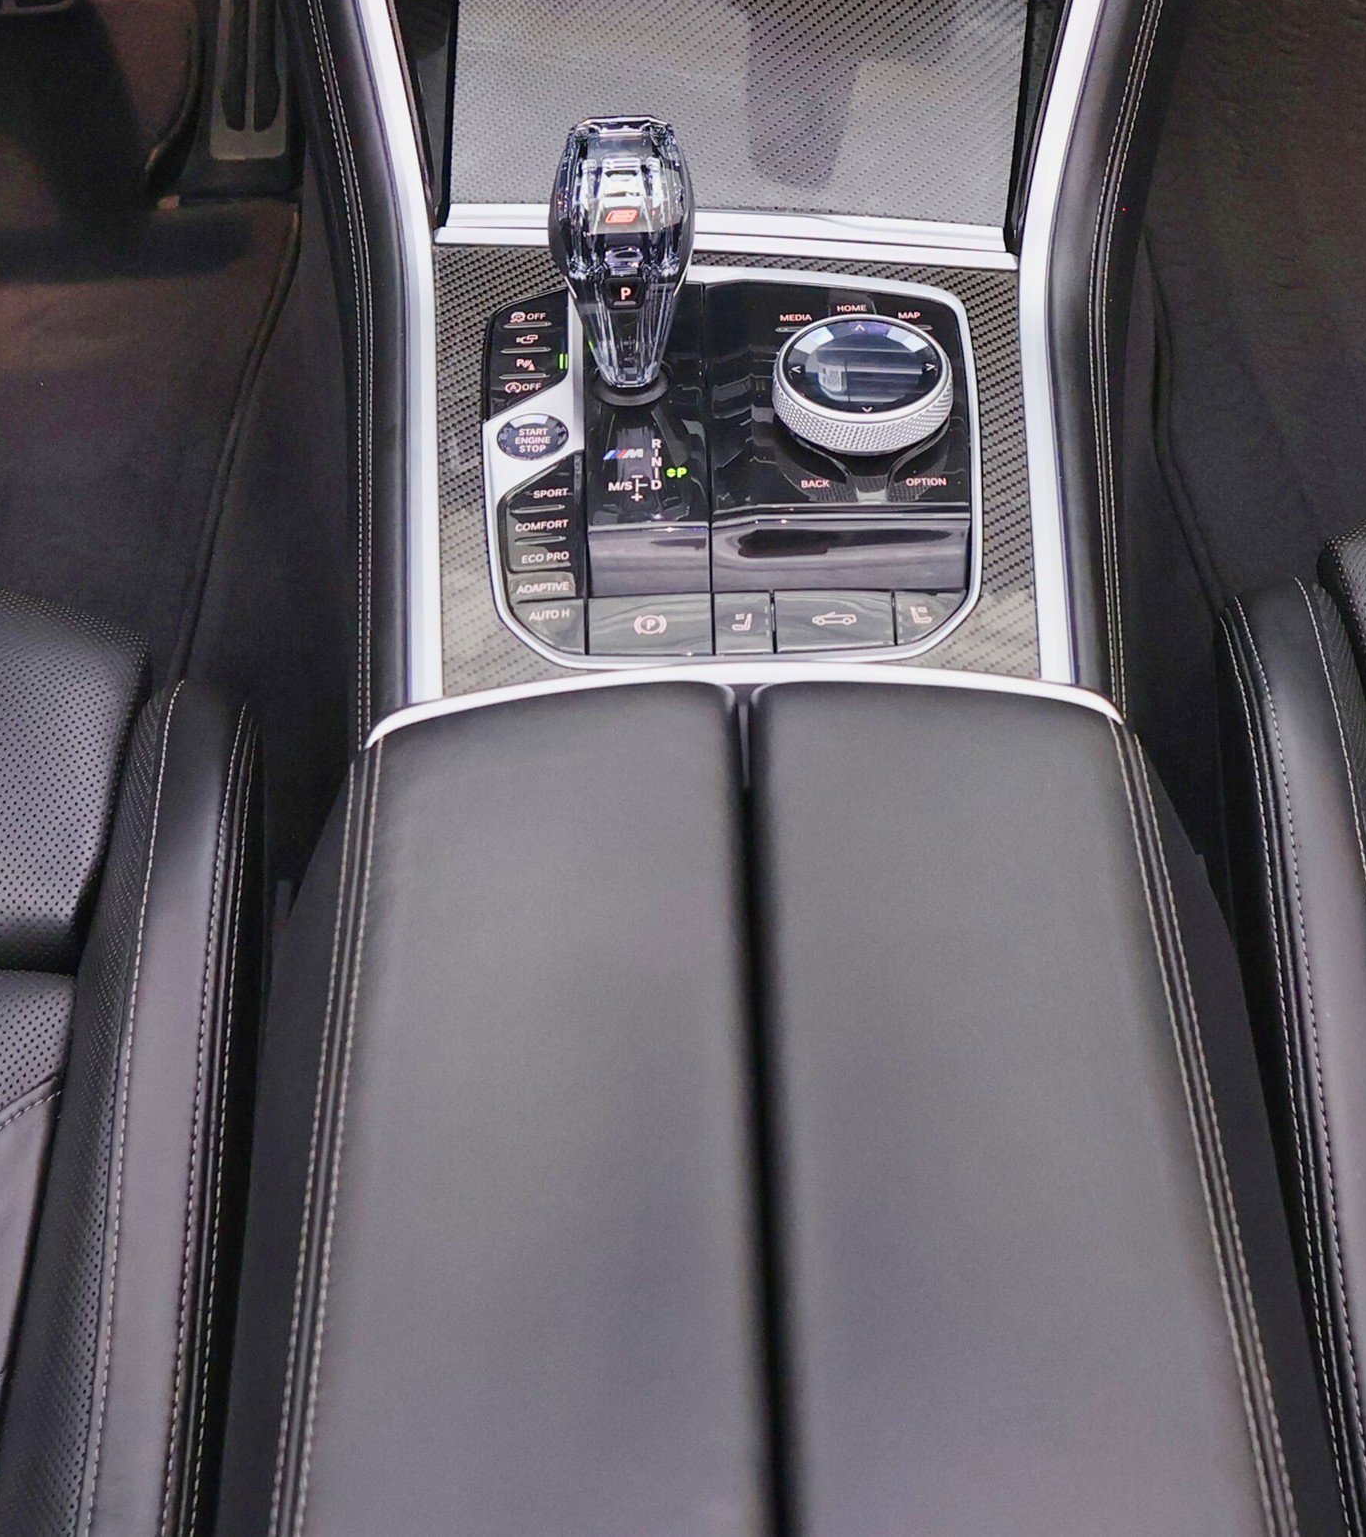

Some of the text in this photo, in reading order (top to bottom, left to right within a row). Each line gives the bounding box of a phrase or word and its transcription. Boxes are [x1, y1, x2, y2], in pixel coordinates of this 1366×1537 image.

[620, 287, 632, 300] P
[837, 305, 867, 313] HOME
[526, 312, 546, 321] OFF
[779, 314, 813, 322] MEDIA
[898, 311, 921, 319] MAP
[521, 383, 542, 391] OFF
[518, 428, 548, 436] START
[514, 436, 551, 444] ENGINE
[519, 445, 547, 453] STOP
[608, 481, 633, 492] M/S
[800, 479, 831, 489] BACK
[905, 477, 947, 487] OPTION
[533, 487, 569, 499] SPORT
[515, 519, 569, 533] COMFORT
[521, 551, 570, 563] ECO PRO
[516, 581, 570, 594] ADAPTIVE
[528, 609, 570, 622] AUTO H
